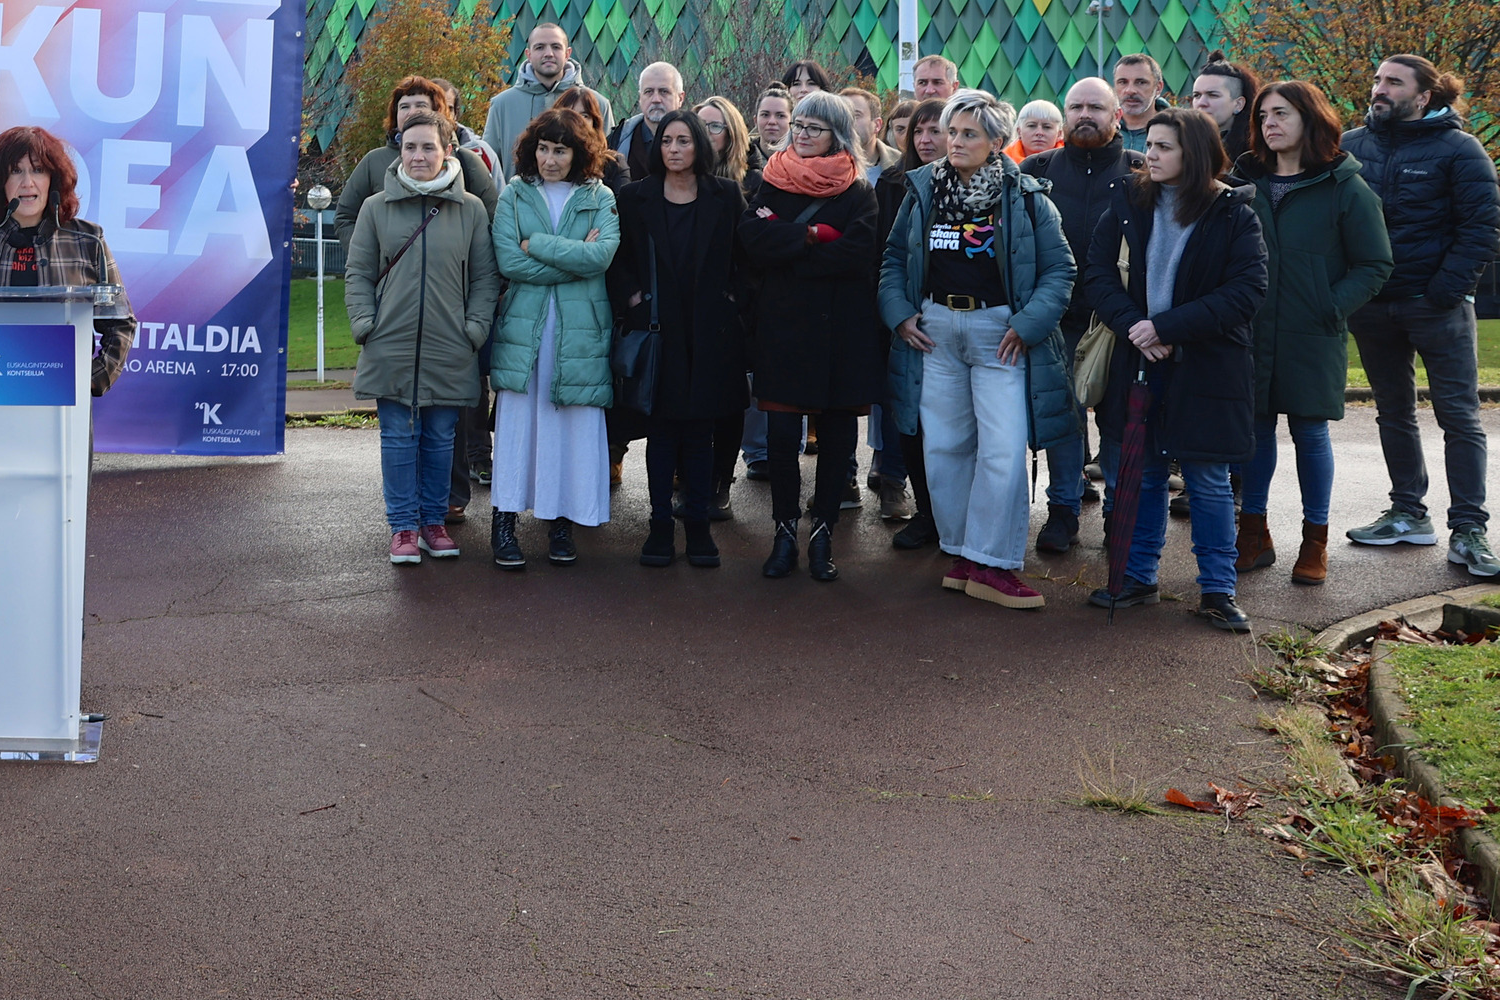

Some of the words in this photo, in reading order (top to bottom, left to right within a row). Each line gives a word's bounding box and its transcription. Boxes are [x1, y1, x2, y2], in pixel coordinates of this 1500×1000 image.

[131, 321, 262, 354] ITALDIA
[6, 361, 64, 369] EUSKALGINTZAREN
[145, 360, 196, 376] ARENA
[220, 363, 259, 377] 17:00
[6, 369, 45, 377] KONTSEILUA
[202, 427, 261, 436] EUSKALGINTZAREN
[202, 436, 241, 444] KONTSEILUA
